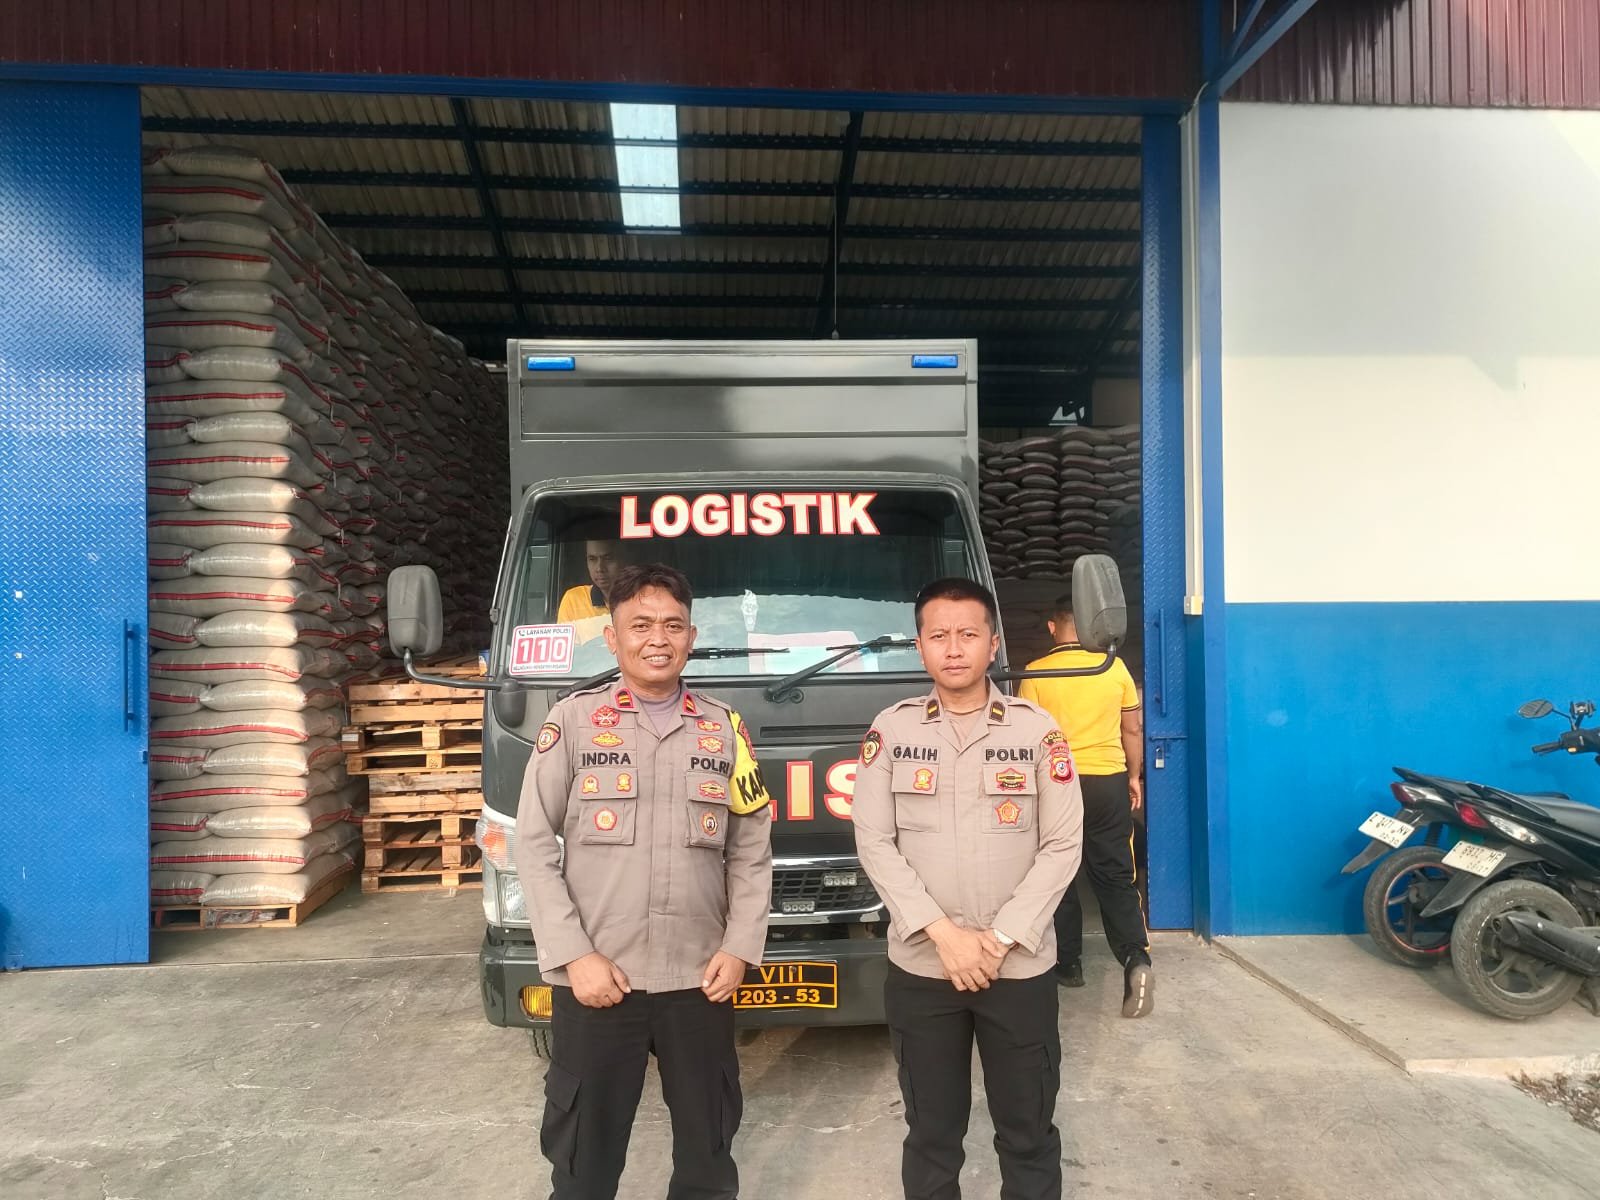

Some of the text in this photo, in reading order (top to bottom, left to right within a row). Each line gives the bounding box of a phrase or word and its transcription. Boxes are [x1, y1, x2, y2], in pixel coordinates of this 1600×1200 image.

[619, 492, 881, 539] LOGISTIK
[518, 638, 567, 663] 110
[582, 752, 631, 767] INDRA
[893, 745, 938, 761] GALIH
[985, 748, 1034, 762] POLRI
[690, 756, 730, 774] POLRI
[759, 965, 803, 984] VIII
[731, 989, 777, 1005] 1203
[796, 988, 820, 1003] 53
